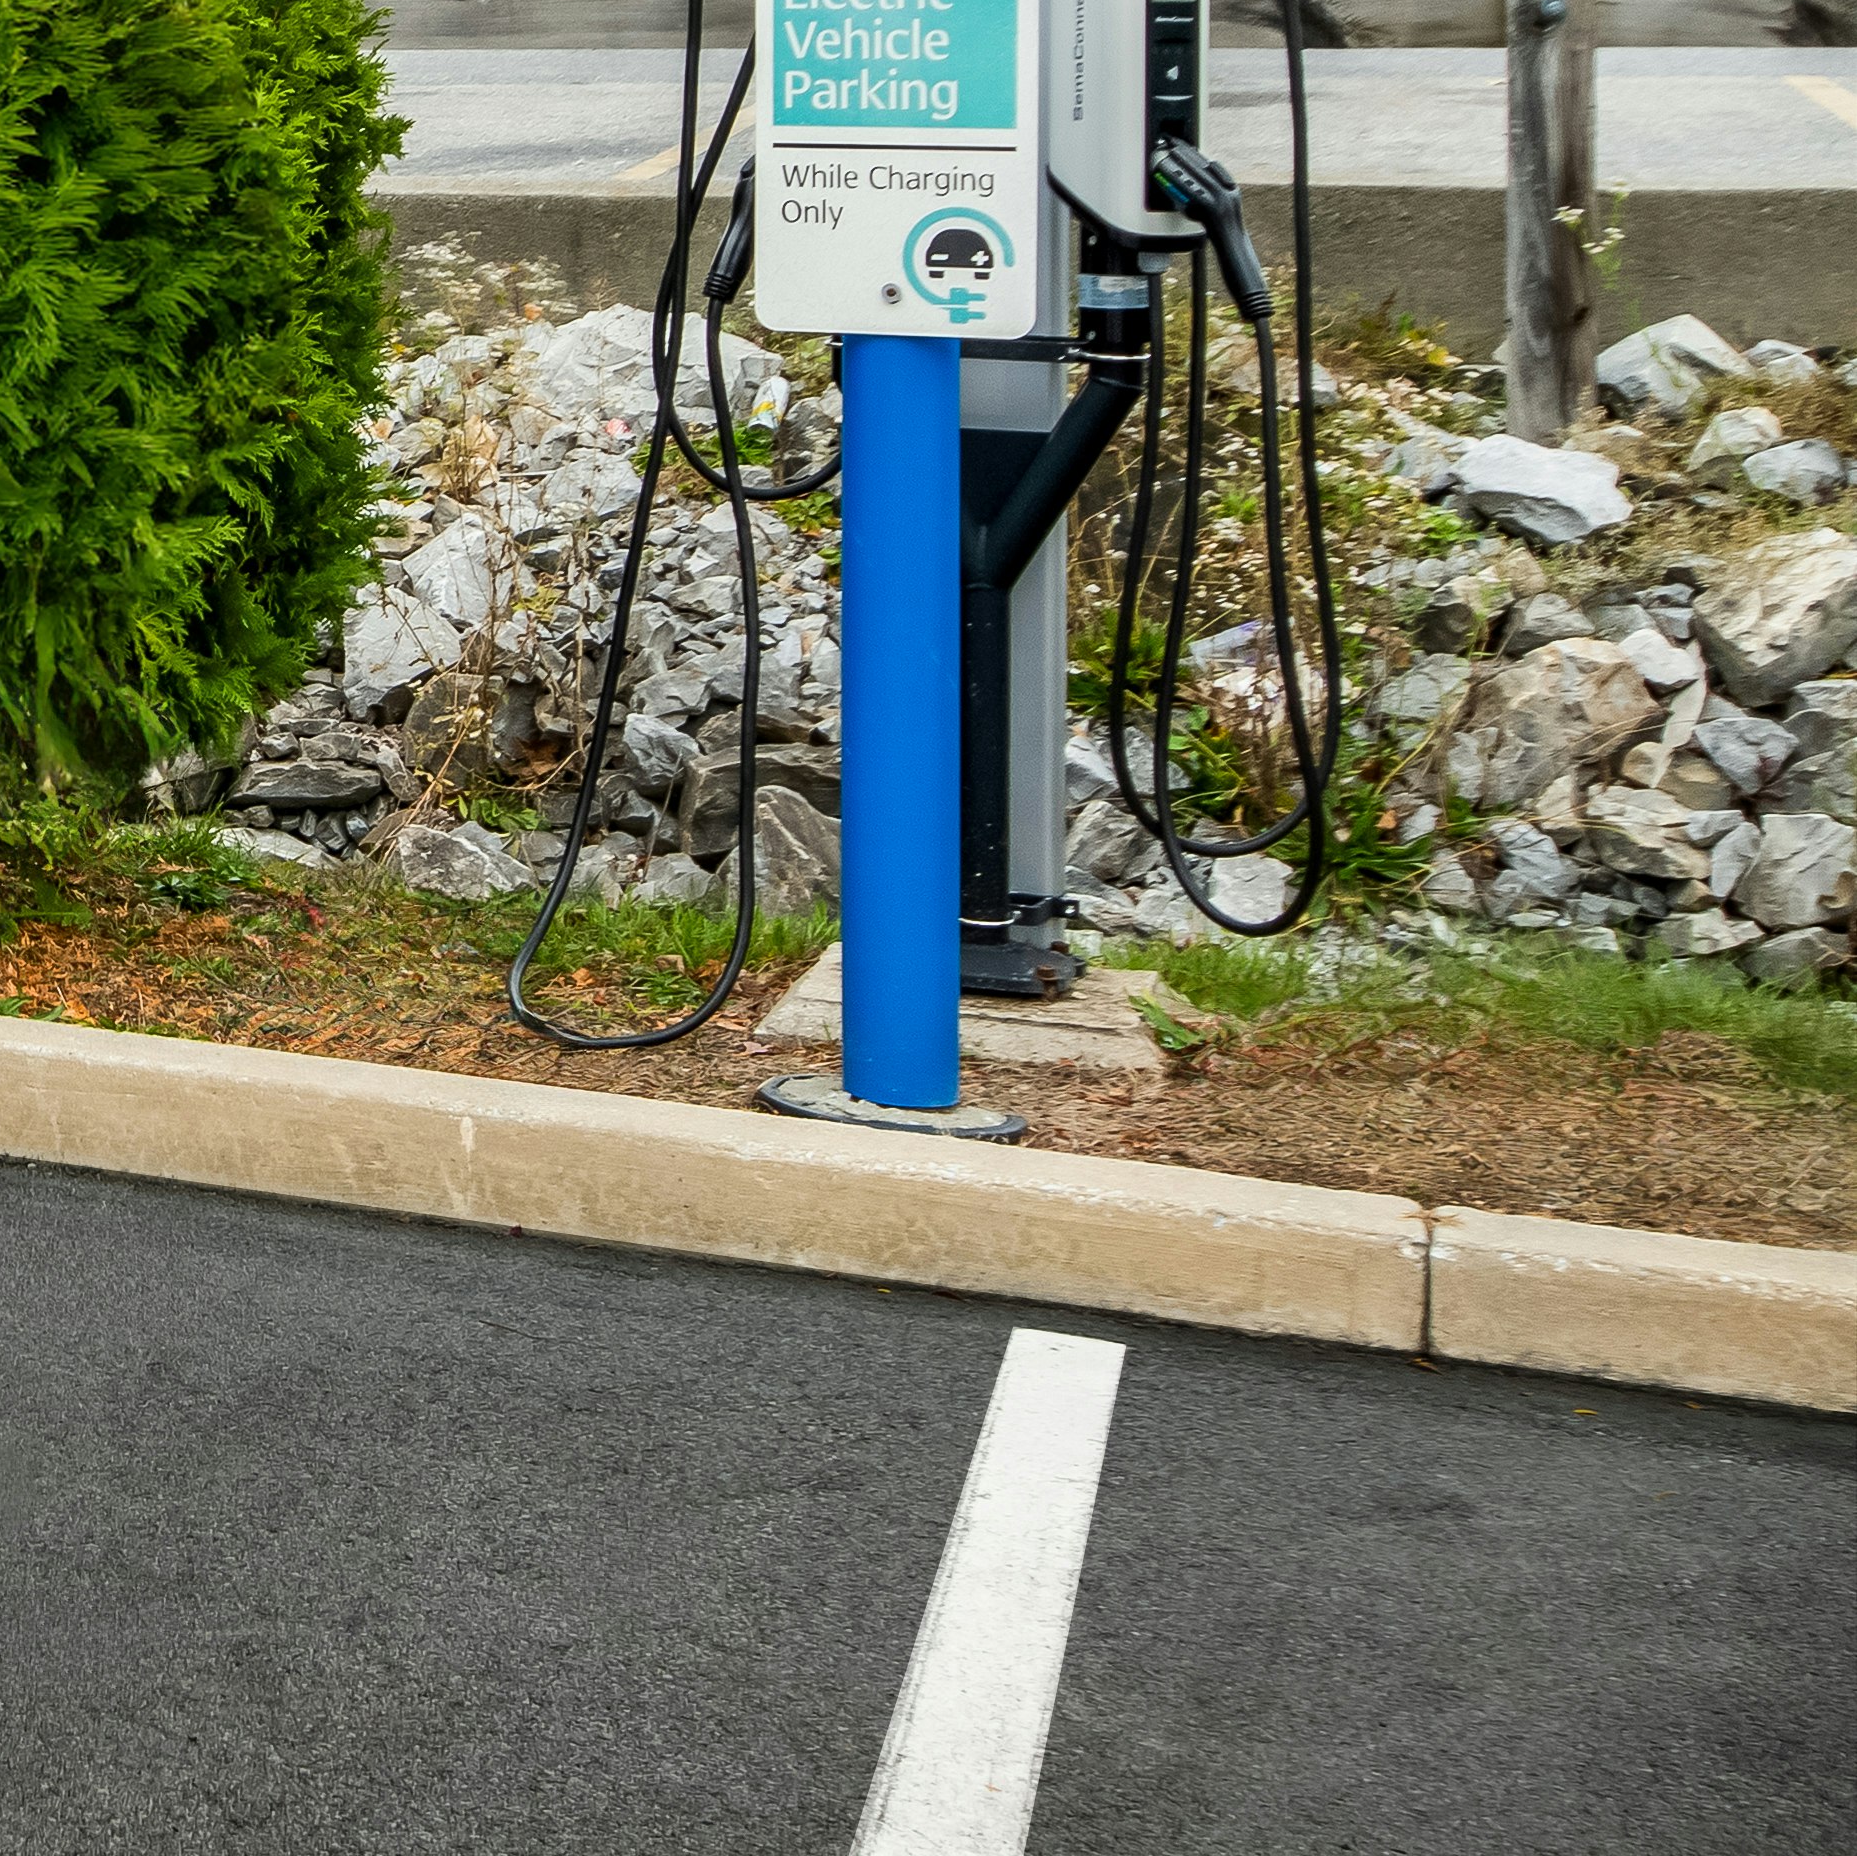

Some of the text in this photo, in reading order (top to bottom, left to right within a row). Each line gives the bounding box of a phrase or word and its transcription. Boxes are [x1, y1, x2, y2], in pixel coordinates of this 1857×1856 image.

[784, 18, 949, 61] Vehicle
[784, 68, 959, 120] Parking
[781, 164, 995, 197] While Charging
[781, 199, 844, 230] Only
